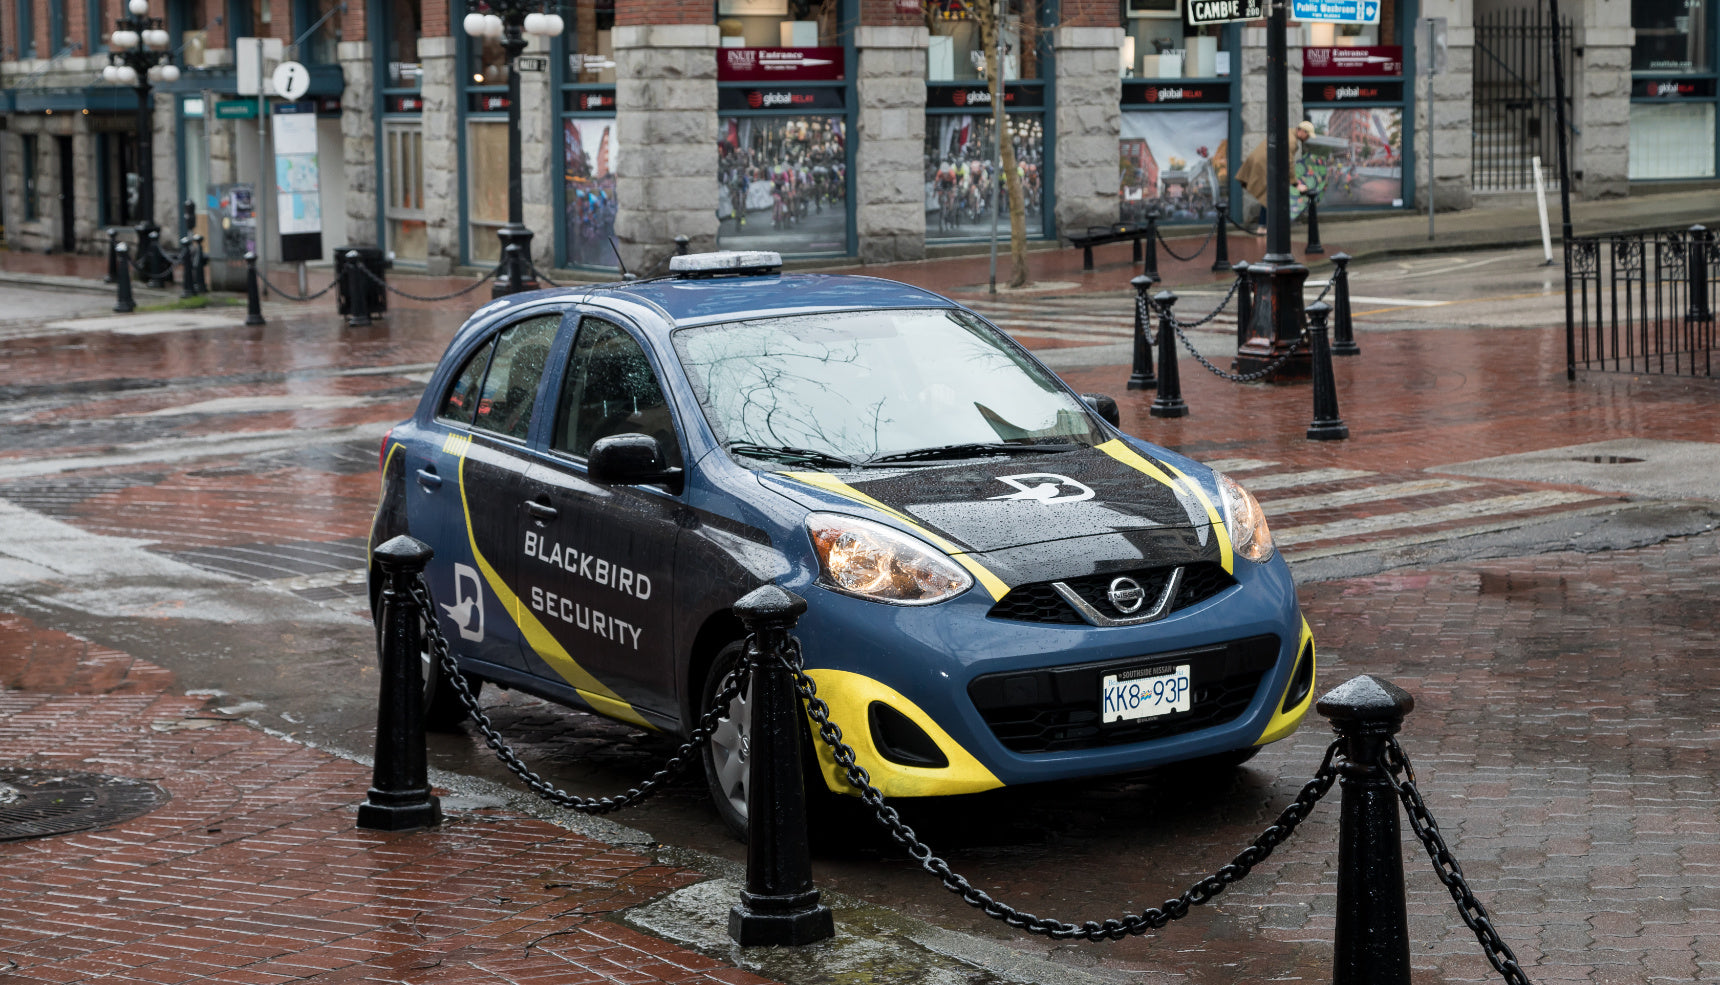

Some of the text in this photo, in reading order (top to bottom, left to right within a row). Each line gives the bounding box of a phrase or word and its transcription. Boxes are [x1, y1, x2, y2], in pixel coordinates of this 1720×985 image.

[1195, 0, 1240, 20] CAMBIE
[1245, 7, 1260, 18] 200
[1296, 3, 1356, 14] Public Washroom
[758, 50, 804, 59] Entrance
[1332, 49, 1369, 57] Entrance
[524, 530, 652, 600] BLACKBIRD
[531, 586, 643, 650] SECURITY
[1122, 668, 1153, 679] SOUTHSIDE
[1152, 665, 1172, 675] NISSAN
[1104, 676, 1189, 713] KK8 93P
